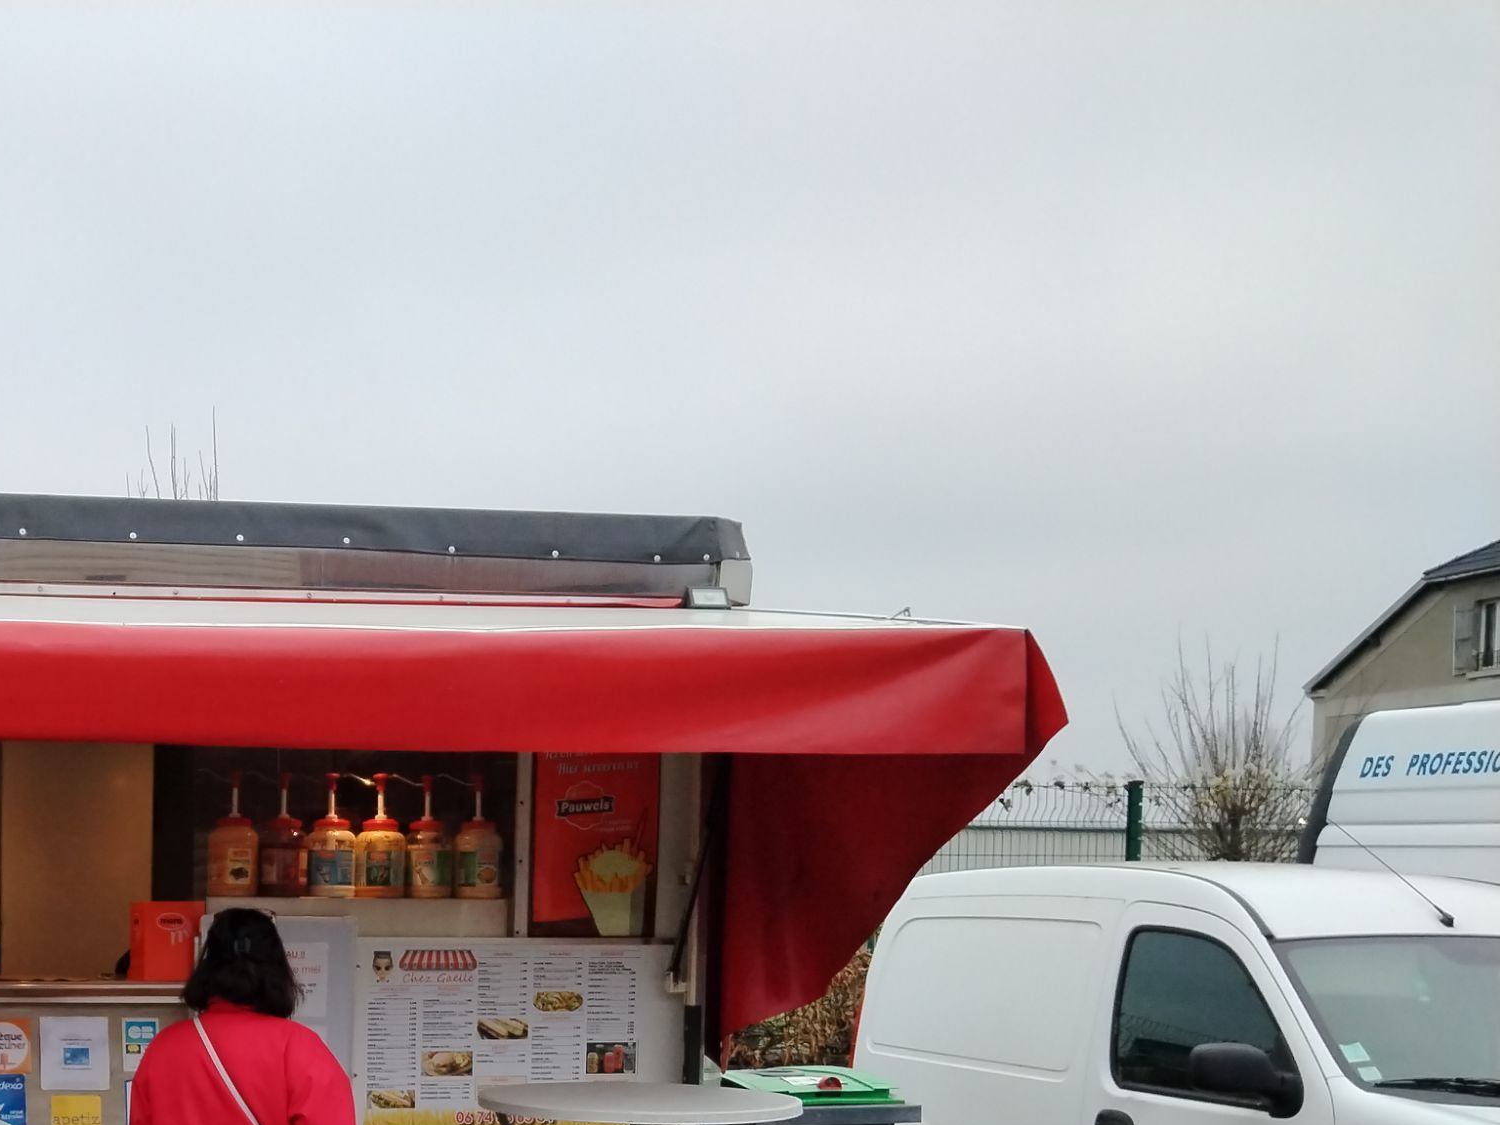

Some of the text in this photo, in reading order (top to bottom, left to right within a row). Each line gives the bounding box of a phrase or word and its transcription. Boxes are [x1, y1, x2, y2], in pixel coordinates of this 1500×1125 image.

[1359, 755, 1395, 779] DES
[560, 799, 611, 813] Pauwels
[402, 971, 432, 984] Chez
[456, 1110, 473, 1124] 06
